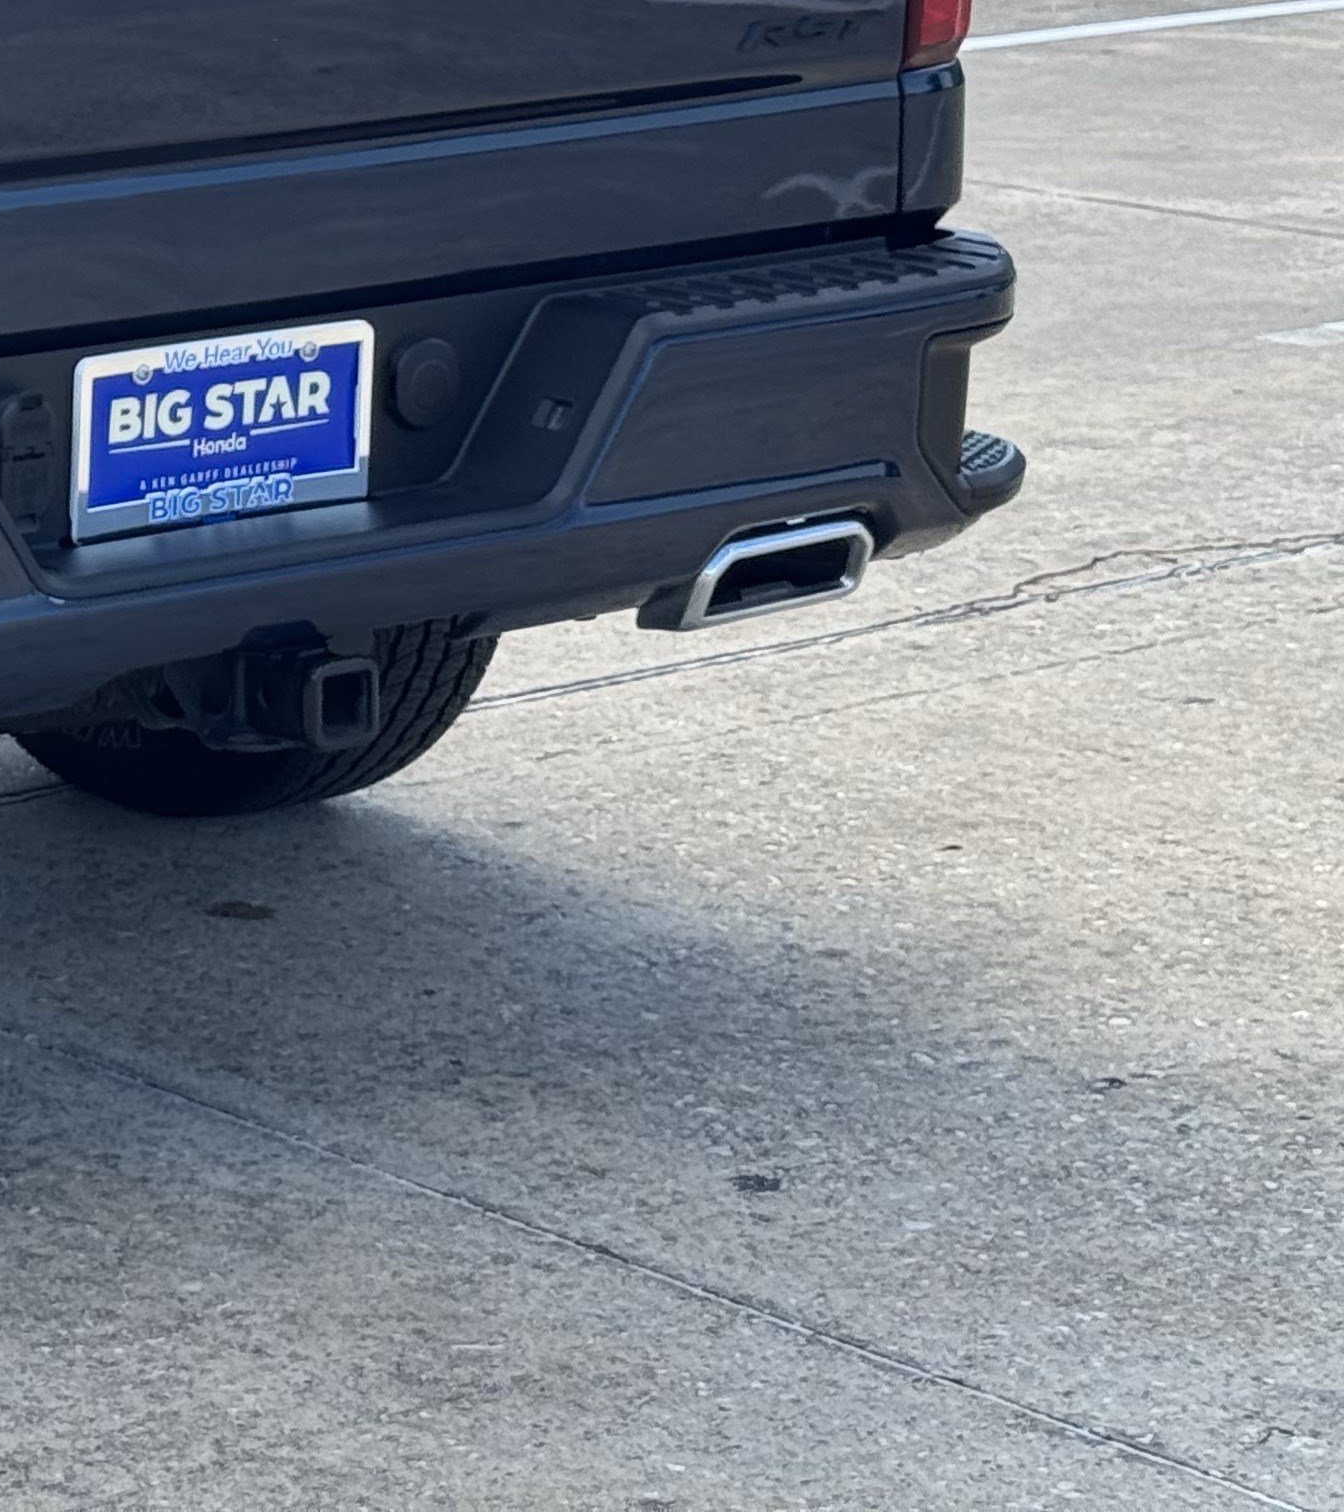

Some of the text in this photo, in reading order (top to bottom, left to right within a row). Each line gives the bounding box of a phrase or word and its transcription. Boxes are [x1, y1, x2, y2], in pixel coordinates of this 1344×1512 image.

[164, 338, 294, 370] We Hear You
[108, 370, 331, 445] BIG STAR
[192, 431, 247, 458] Honda
[150, 491, 201, 521] BIG
[210, 479, 293, 511] STAR
